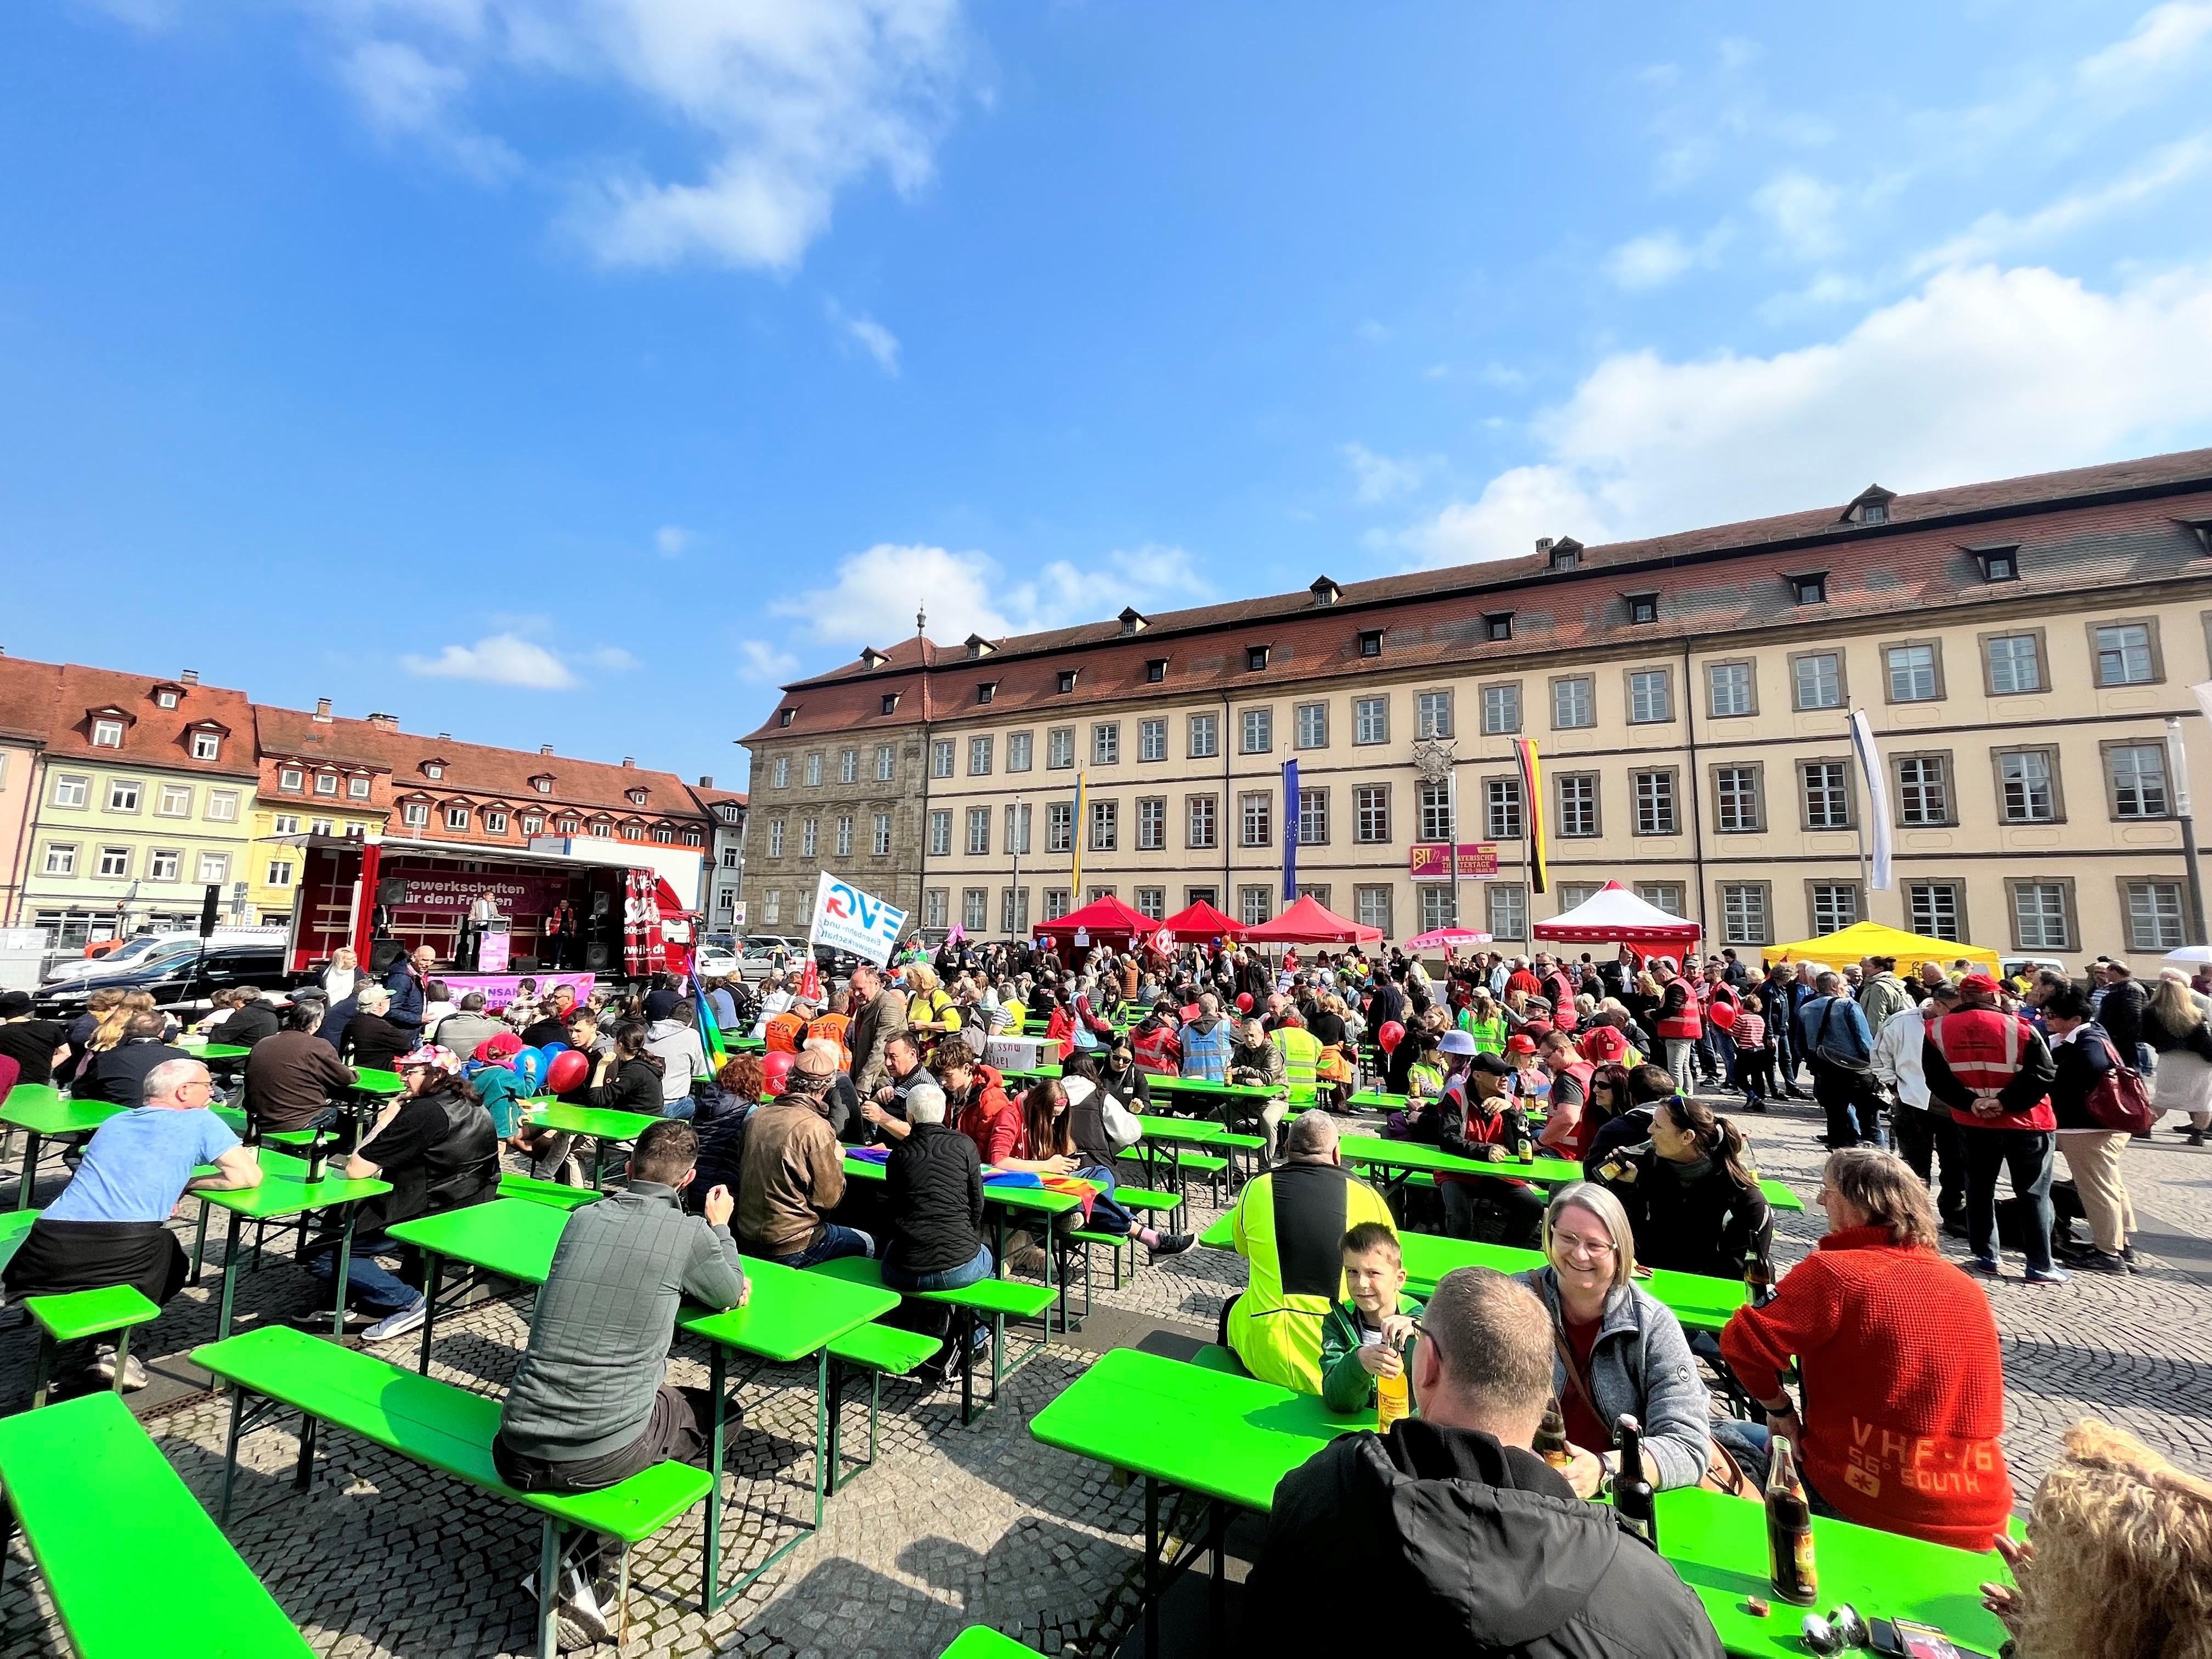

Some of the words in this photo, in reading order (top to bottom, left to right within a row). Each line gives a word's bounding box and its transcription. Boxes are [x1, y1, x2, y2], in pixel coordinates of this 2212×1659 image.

[405, 891, 421, 904] ür
[424, 893, 455, 905] den
[457, 894, 512, 906] Frien
[813, 1023, 837, 1032] EVG
[1900, 1468, 1981, 1493] SOUTH
